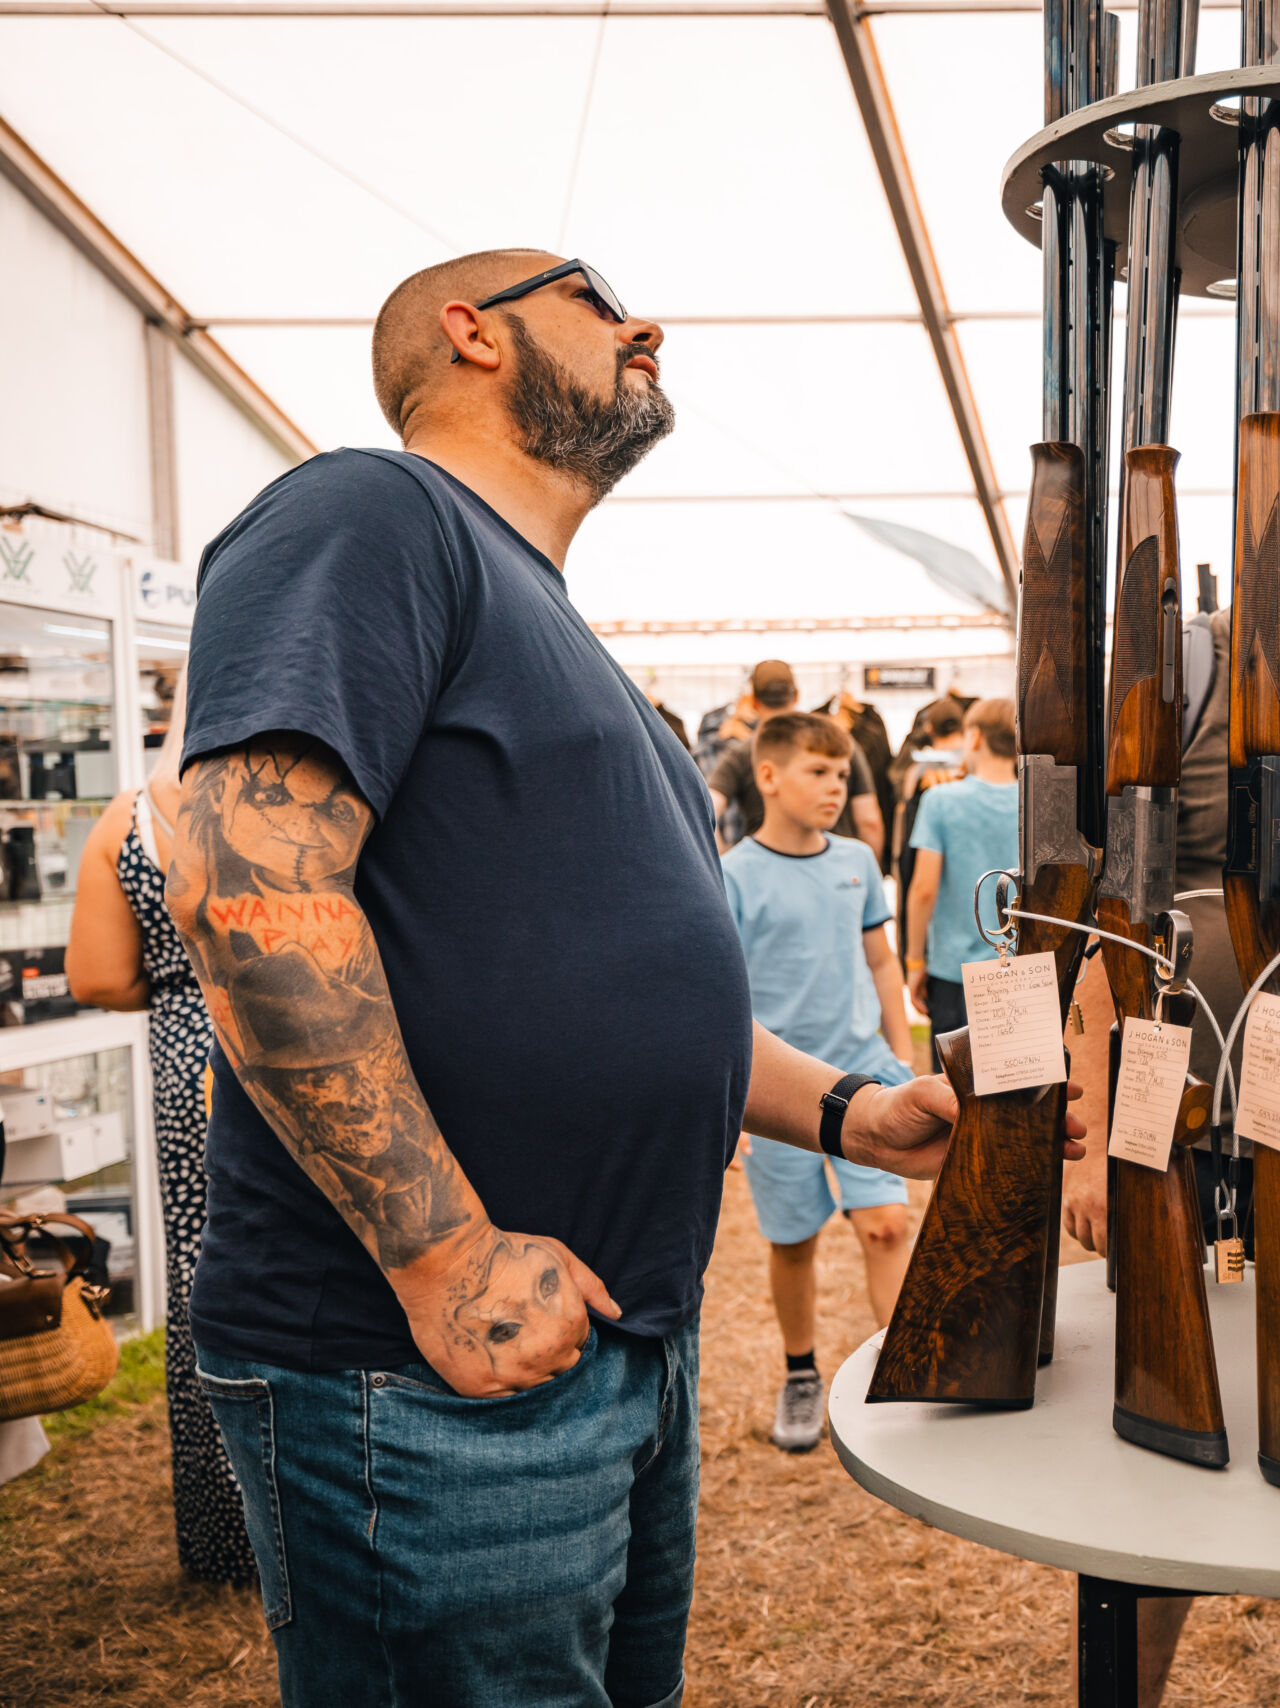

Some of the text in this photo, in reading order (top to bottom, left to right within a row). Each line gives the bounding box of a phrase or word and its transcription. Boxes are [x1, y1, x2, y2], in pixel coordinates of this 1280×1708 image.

[210, 899, 360, 927] WANNA
[969, 975, 974, 983] J
[979, 969, 1017, 981] HOGAN
[1028, 964, 1050, 974] SON
[1254, 1004, 1259, 1013] J
[1128, 1030, 1132, 1038] J
[1135, 1031, 1163, 1043] HOGAN
[1171, 1037, 1187, 1048] SON
